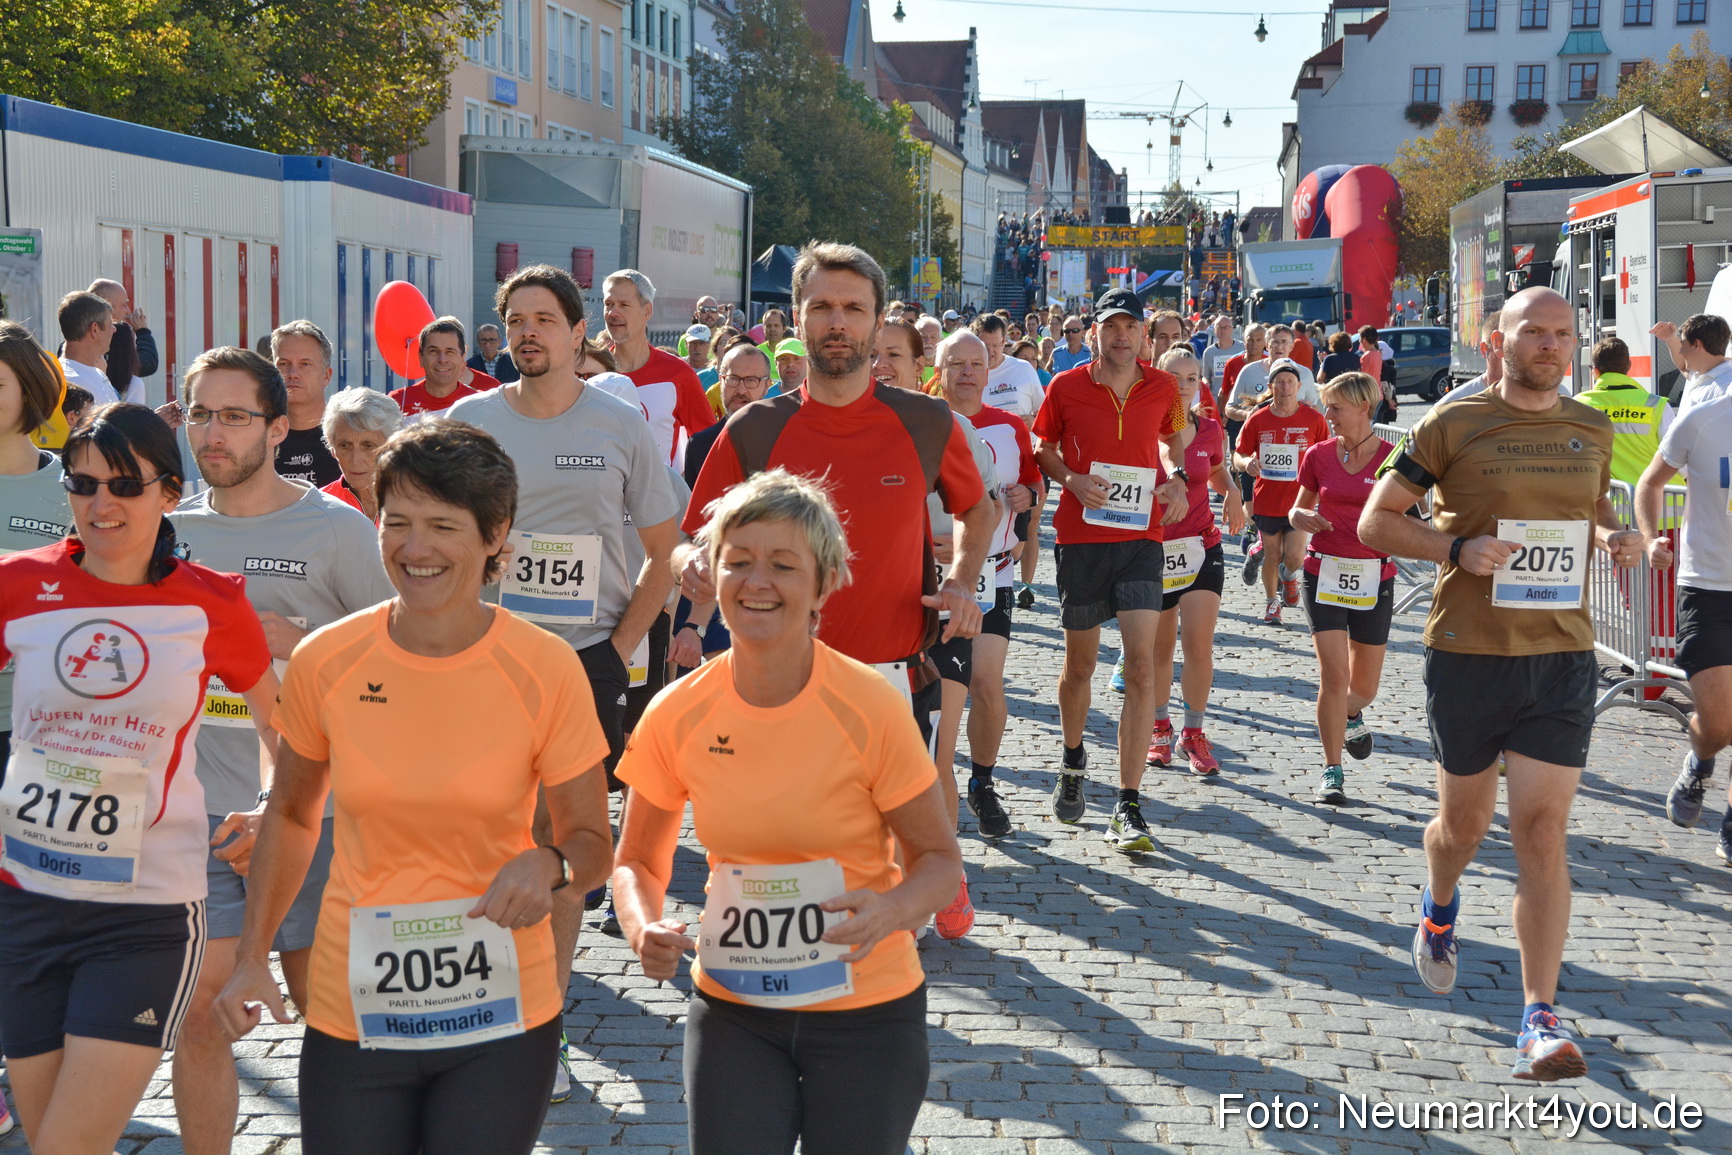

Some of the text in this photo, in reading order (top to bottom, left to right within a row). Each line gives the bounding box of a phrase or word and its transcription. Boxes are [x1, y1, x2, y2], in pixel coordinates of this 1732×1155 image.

[1092, 230, 1140, 242] START
[2, 244, 26, 252] Oktober
[1270, 263, 1314, 273] BOCK
[1604, 408, 1646, 419] Leiter
[1196, 450, 1208, 458] Julia
[1497, 442, 1566, 454] elements
[555, 455, 606, 467] BOCK
[1264, 453, 1292, 466] 2286
[1109, 470, 1139, 480] BOCK
[1482, 467, 1502, 476] BAD
[1108, 482, 1142, 504] 241
[1103, 511, 1131, 523] Jürgen
[9, 516, 66, 536] BOCK
[1526, 529, 1565, 539] BOCK
[532, 540, 574, 553] BOCK
[1166, 553, 1188, 571] 54
[1510, 545, 1574, 573] 2075
[244, 557, 307, 576] BOCK
[516, 556, 584, 587] 3154
[1338, 562, 1364, 571] BOCK
[1171, 578, 1186, 588] Julia
[1338, 573, 1360, 591] 55
[36, 593, 64, 602] erima
[520, 586, 570, 597] PARTL Neumarkt
[1525, 586, 1558, 600] André
[1336, 595, 1359, 605] Maria
[359, 694, 387, 704] erima
[207, 699, 252, 716] Johan
[89, 712, 118, 726] MIT
[125, 715, 166, 738] HERZ
[58, 724, 81, 737] Heck
[91, 732, 107, 742] Dr.
[109, 735, 146, 752] Röschl
[709, 746, 735, 755] erima
[46, 759, 102, 784] BOCK
[17, 782, 119, 836] 2178
[23, 829, 93, 850] PARTL Neumarkt
[39, 851, 82, 876] Doris
[743, 879, 800, 895] BOCK
[393, 915, 464, 937] BOCK
[719, 903, 825, 949] 2070
[729, 954, 806, 965] PARTL Neumarkt
[375, 940, 493, 994] 2054
[762, 974, 789, 992] Evi
[389, 992, 472, 1008] PARTL Neumarkt
[385, 1008, 494, 1036] Heidemarie
